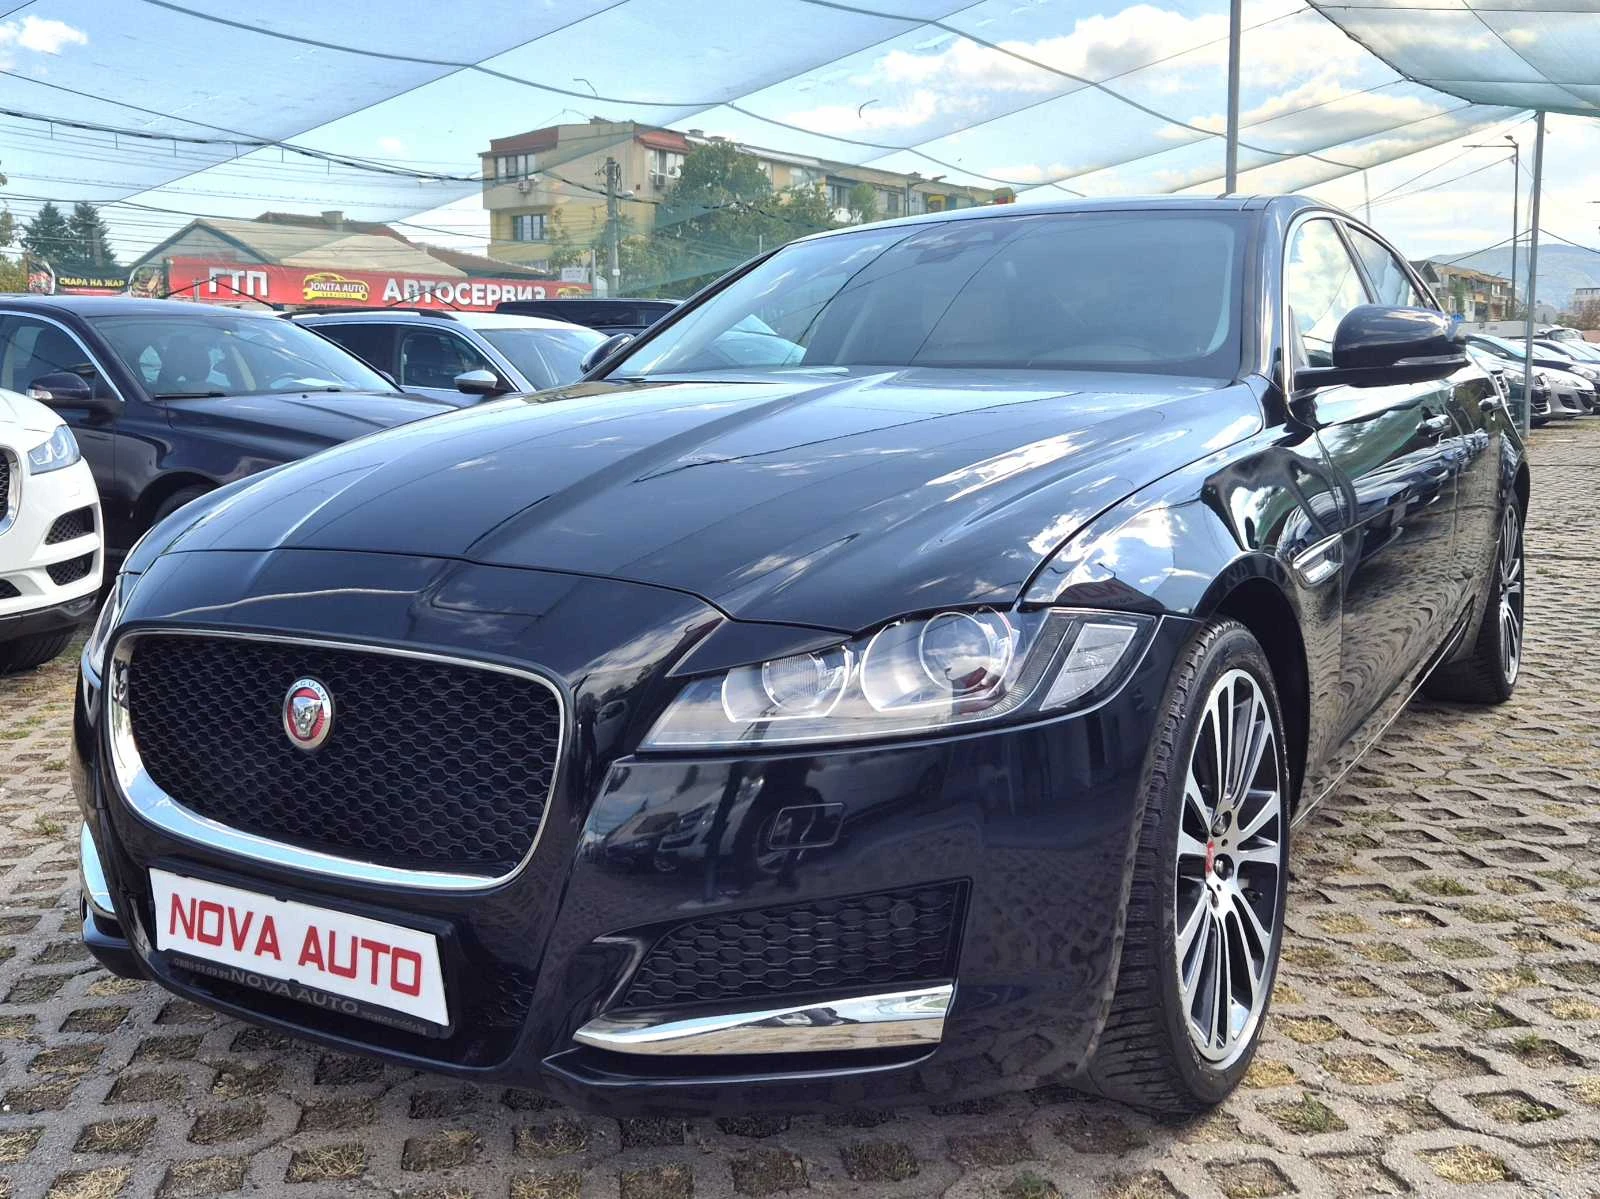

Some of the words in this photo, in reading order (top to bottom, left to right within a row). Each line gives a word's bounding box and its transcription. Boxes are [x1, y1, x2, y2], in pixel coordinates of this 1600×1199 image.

[59, 277, 88, 287] СКАРА
[90, 278, 103, 287] НА
[104, 279, 125, 288] ЖАР
[208, 266, 268, 296] ГТП
[310, 280, 341, 292] JONITA
[342, 282, 366, 293] AUTO
[382, 277, 546, 306] АВТОСЕРВИЗ
[168, 892, 282, 961] NOVA
[297, 925, 422, 997] AUTO
[231, 968, 292, 998] NOVA
[296, 987, 359, 1014] AUTO
